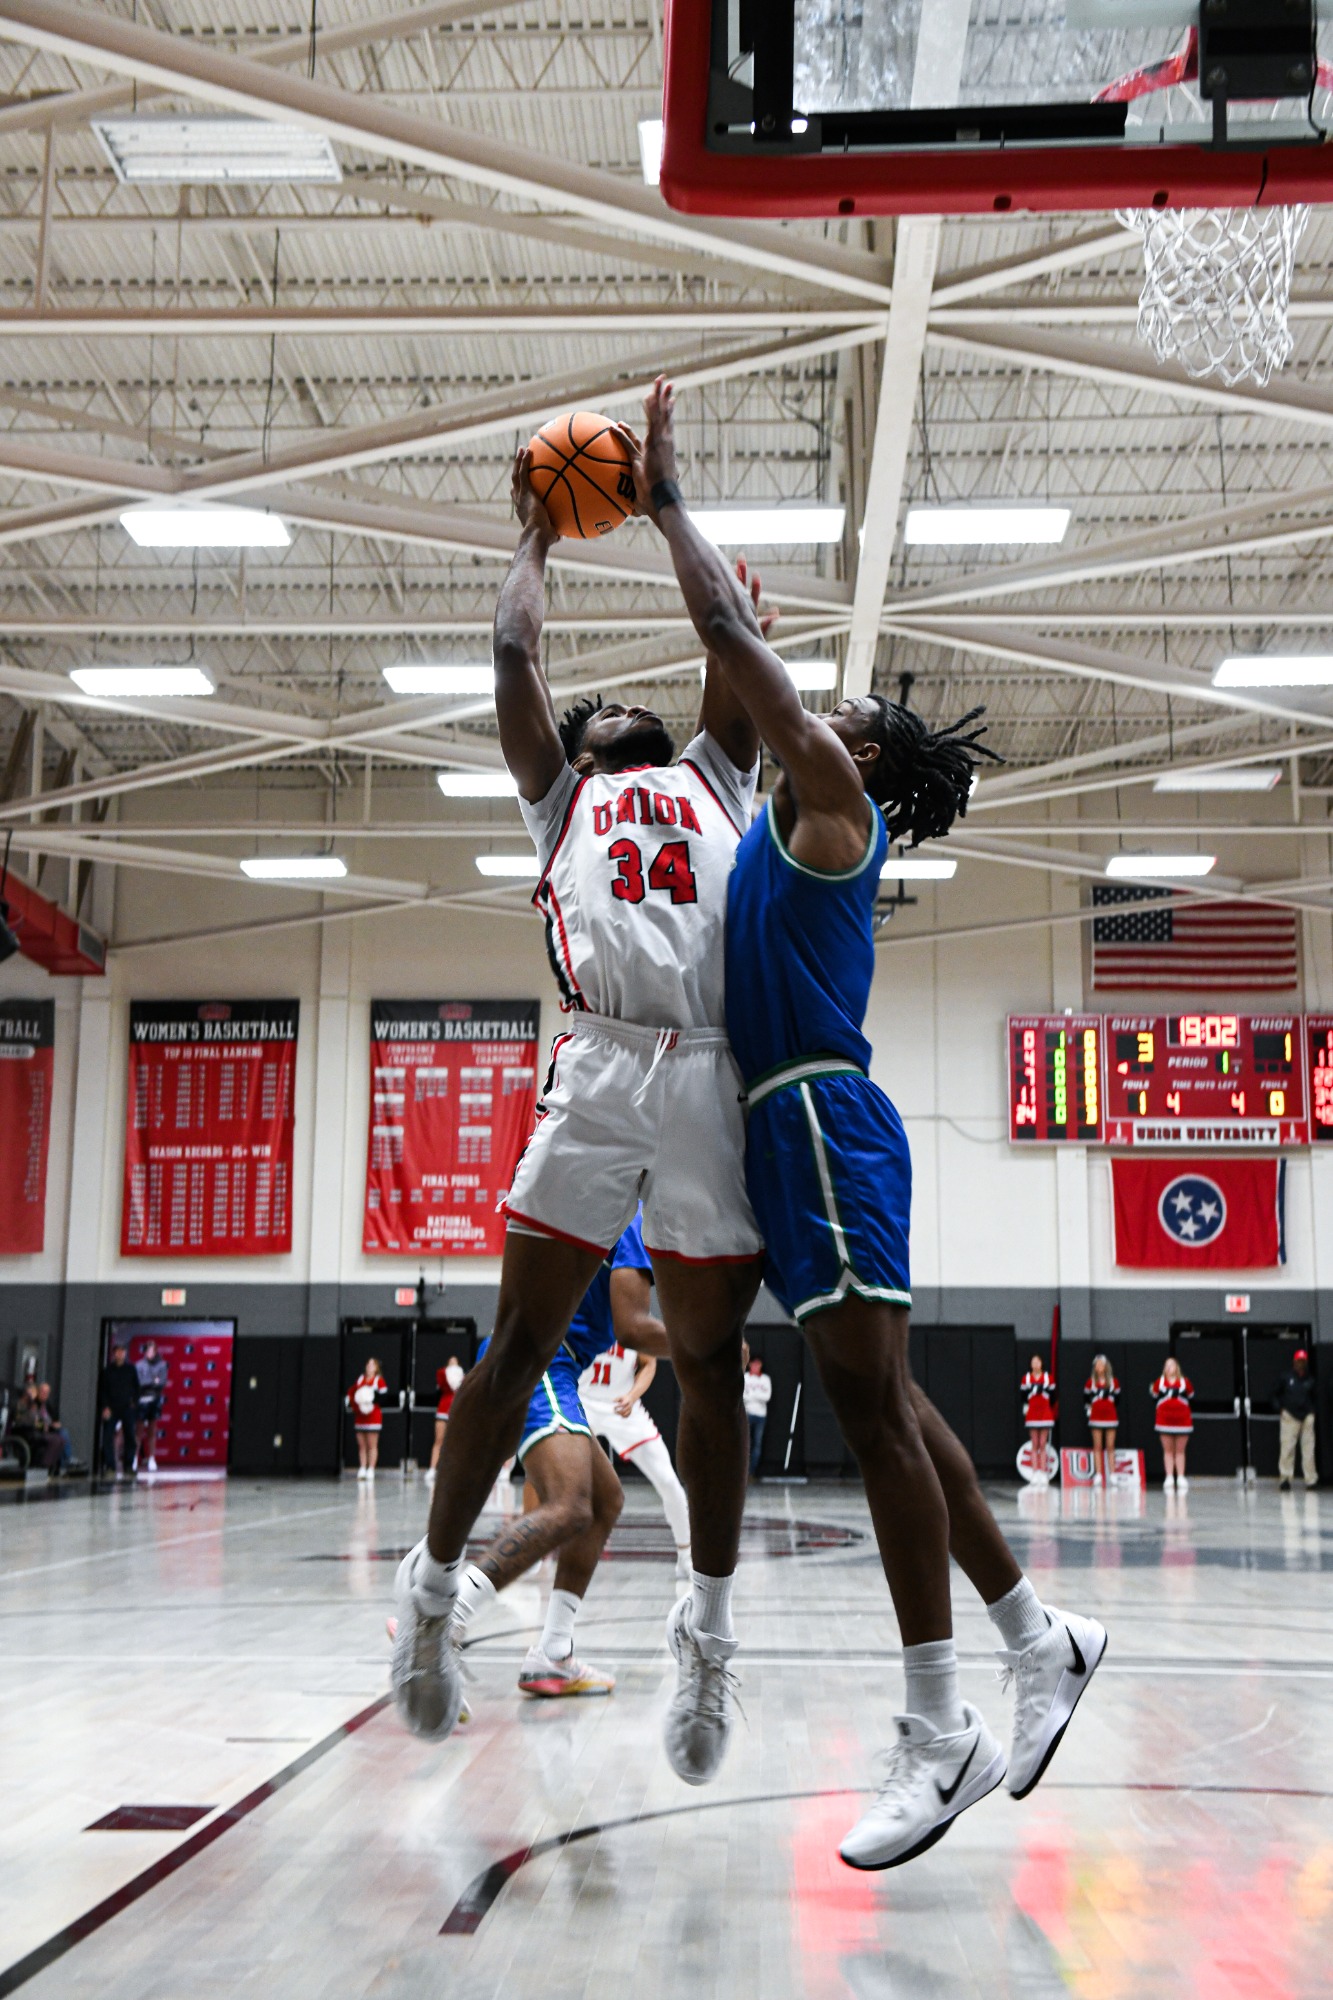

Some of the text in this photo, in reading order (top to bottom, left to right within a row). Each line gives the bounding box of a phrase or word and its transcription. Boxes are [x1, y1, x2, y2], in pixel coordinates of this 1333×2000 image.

[593, 787, 702, 836] UNION
[608, 837, 698, 905] 34
[134, 1020, 294, 1040] WOMEN'S BASKETBALL
[374, 1020, 536, 1040] WOMEN'S BASKETBALL
[1111, 1019, 1155, 1031] GUEST
[1179, 1016, 1238, 1047] 19:02
[1250, 1019, 1293, 1030] UNION
[194, 1046, 220, 1058] FINAL
[1137, 1032, 1154, 1062] 3
[1285, 1032, 1292, 1062] 1
[1168, 1050, 1229, 1074] PERIOD 1
[1122, 1080, 1150, 1090] FOULS
[1217, 1080, 1238, 1090] LEFT
[1260, 1080, 1288, 1090] FOULS
[1139, 1090, 1147, 1116] 1
[1166, 1091, 1180, 1116] 4
[1231, 1090, 1245, 1116] 4
[1270, 1090, 1285, 1116] 0
[1136, 1127, 1278, 1140] UNION UNIVERSITY
[252, 1144, 271, 1157] WIN
[422, 1174, 448, 1187] FINAL
[427, 1214, 472, 1227] NATIONAL
[413, 1226, 485, 1240] CHAMPIONSHIPS
[590, 1361, 611, 1386] 11
